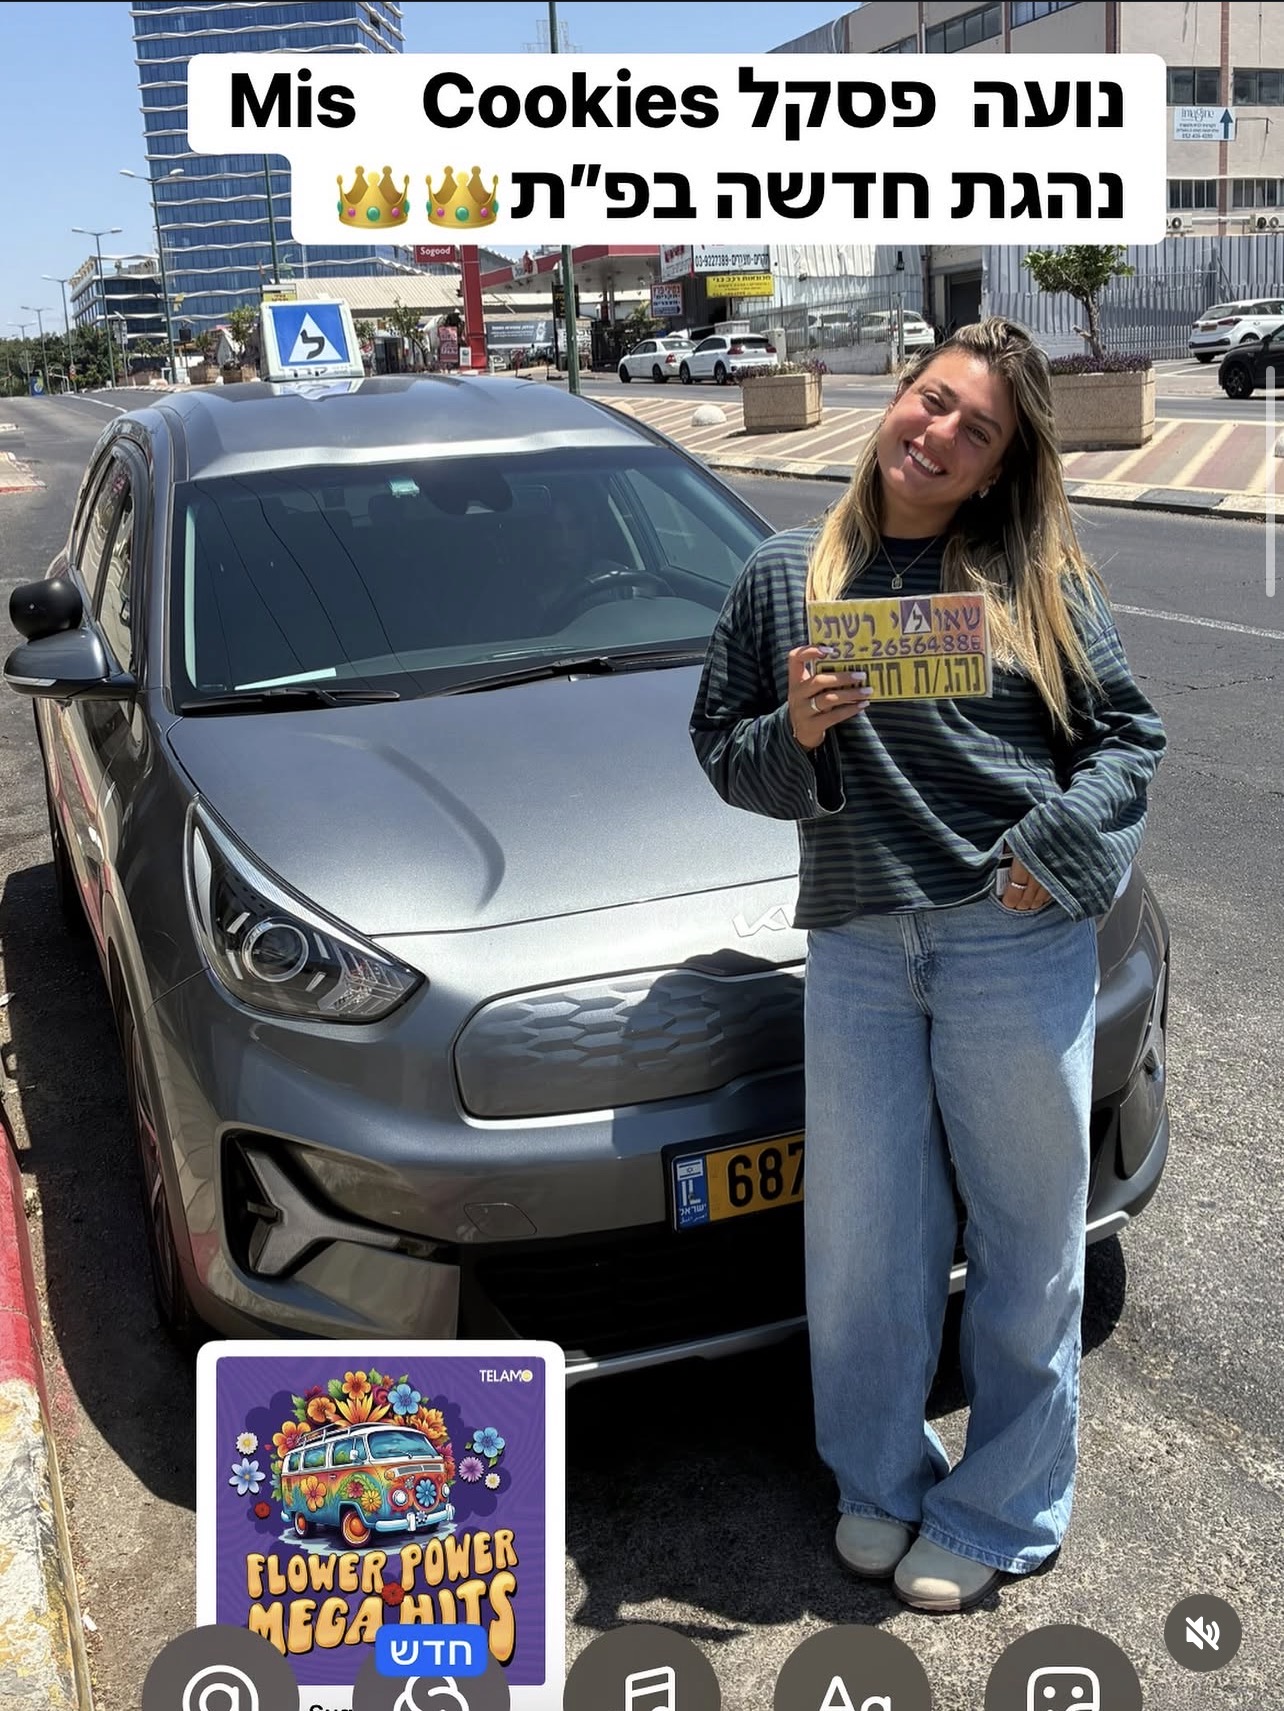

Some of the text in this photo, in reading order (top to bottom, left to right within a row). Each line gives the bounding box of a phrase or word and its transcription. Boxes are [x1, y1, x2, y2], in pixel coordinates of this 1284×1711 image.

[420, 246, 451, 257] Sogood
[300, 329, 325, 360] ל
[813, 611, 876, 639] רשתי
[913, 656, 982, 695] נהג/ת
[681, 1179, 701, 1206] IL
[678, 1203, 707, 1216] ישראל
